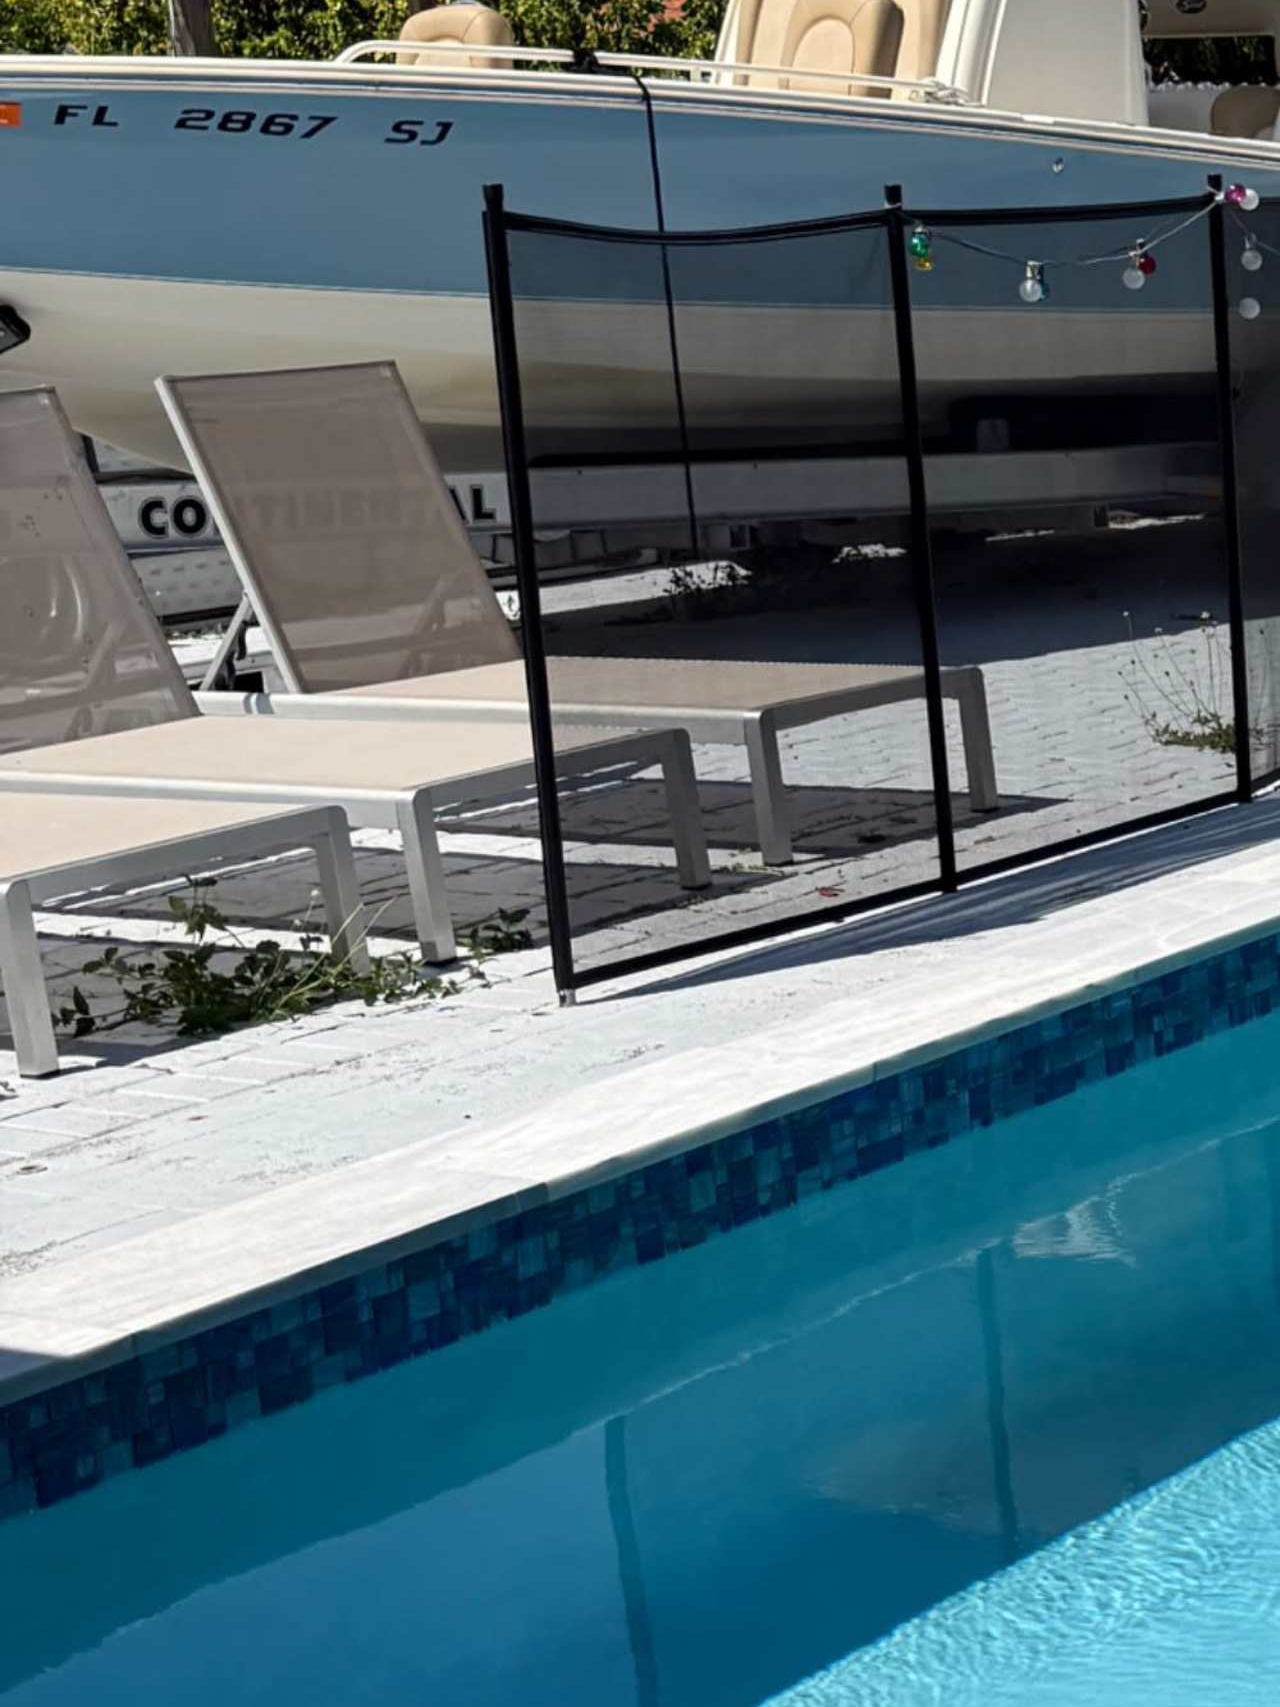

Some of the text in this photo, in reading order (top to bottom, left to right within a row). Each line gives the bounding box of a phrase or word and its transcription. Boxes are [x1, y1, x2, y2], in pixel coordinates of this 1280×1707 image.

[53, 104, 119, 127] FL
[173, 108, 339, 139] 2867
[384, 119, 454, 146] SJ
